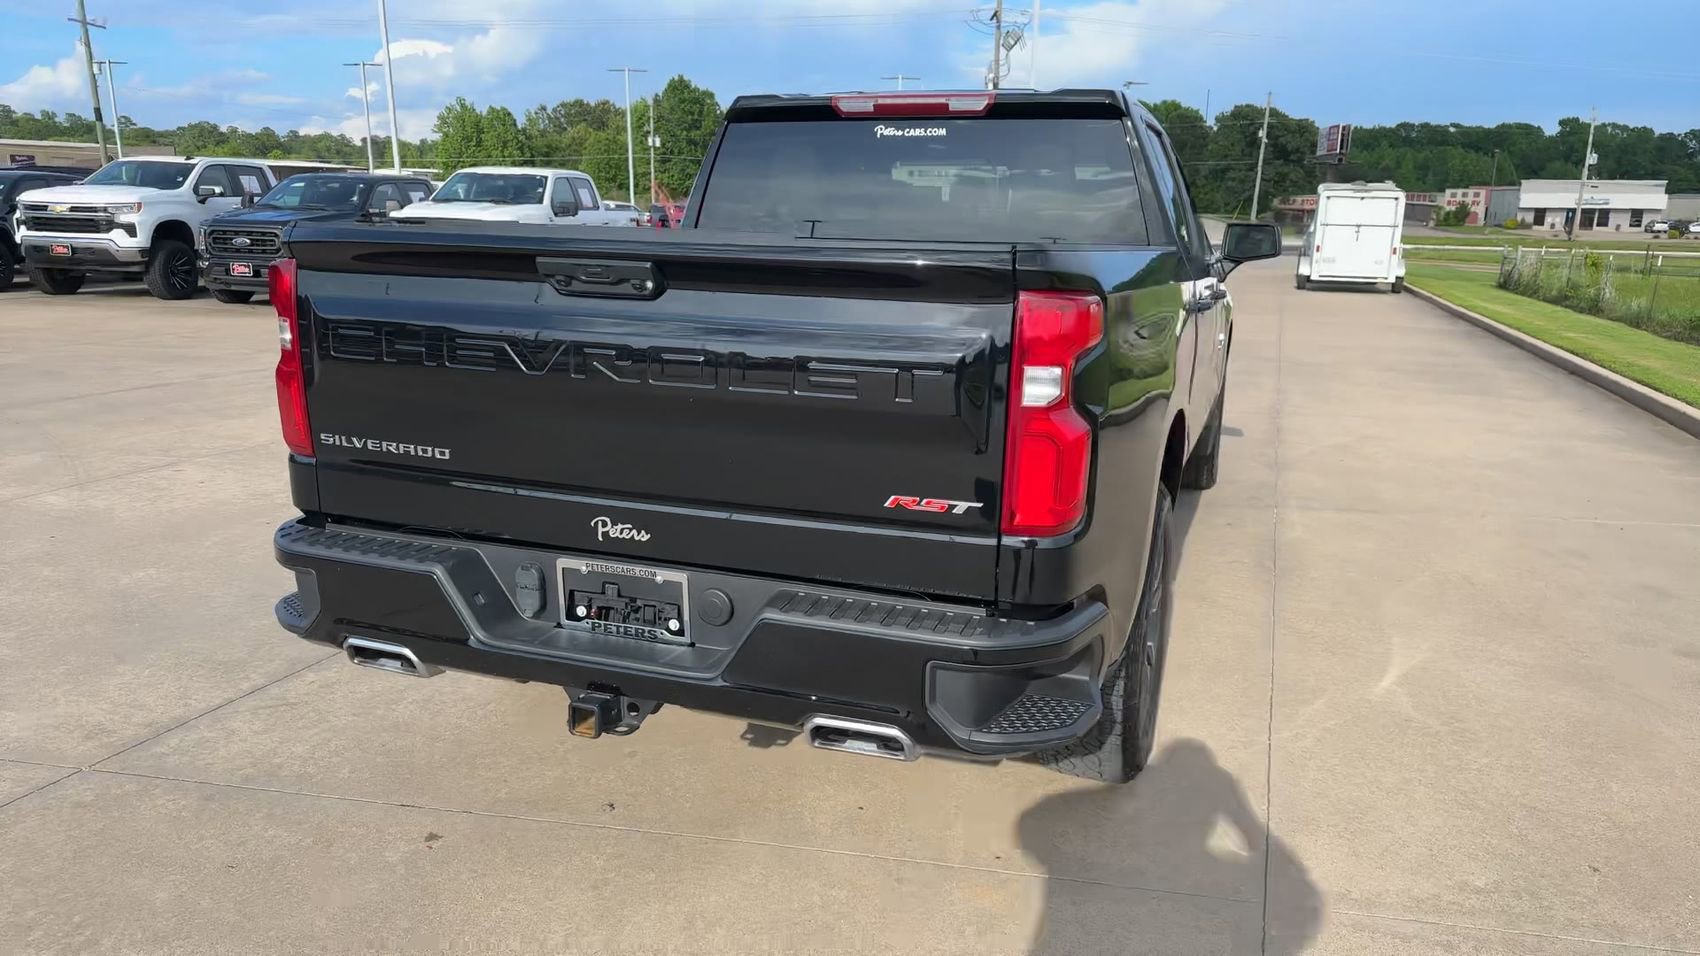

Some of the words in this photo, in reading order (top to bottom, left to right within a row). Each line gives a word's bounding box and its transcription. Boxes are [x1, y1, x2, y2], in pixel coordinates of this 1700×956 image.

[874, 125, 903, 138] Peters
[904, 127, 946, 137] CARS.COM
[326, 322, 946, 404] CHEVROLET
[319, 433, 451, 461] SILVERADO
[883, 495, 984, 515] RST
[590, 517, 651, 541] Peters
[586, 562, 657, 578] PETERSCARS.COM
[591, 621, 657, 640] PETERS
